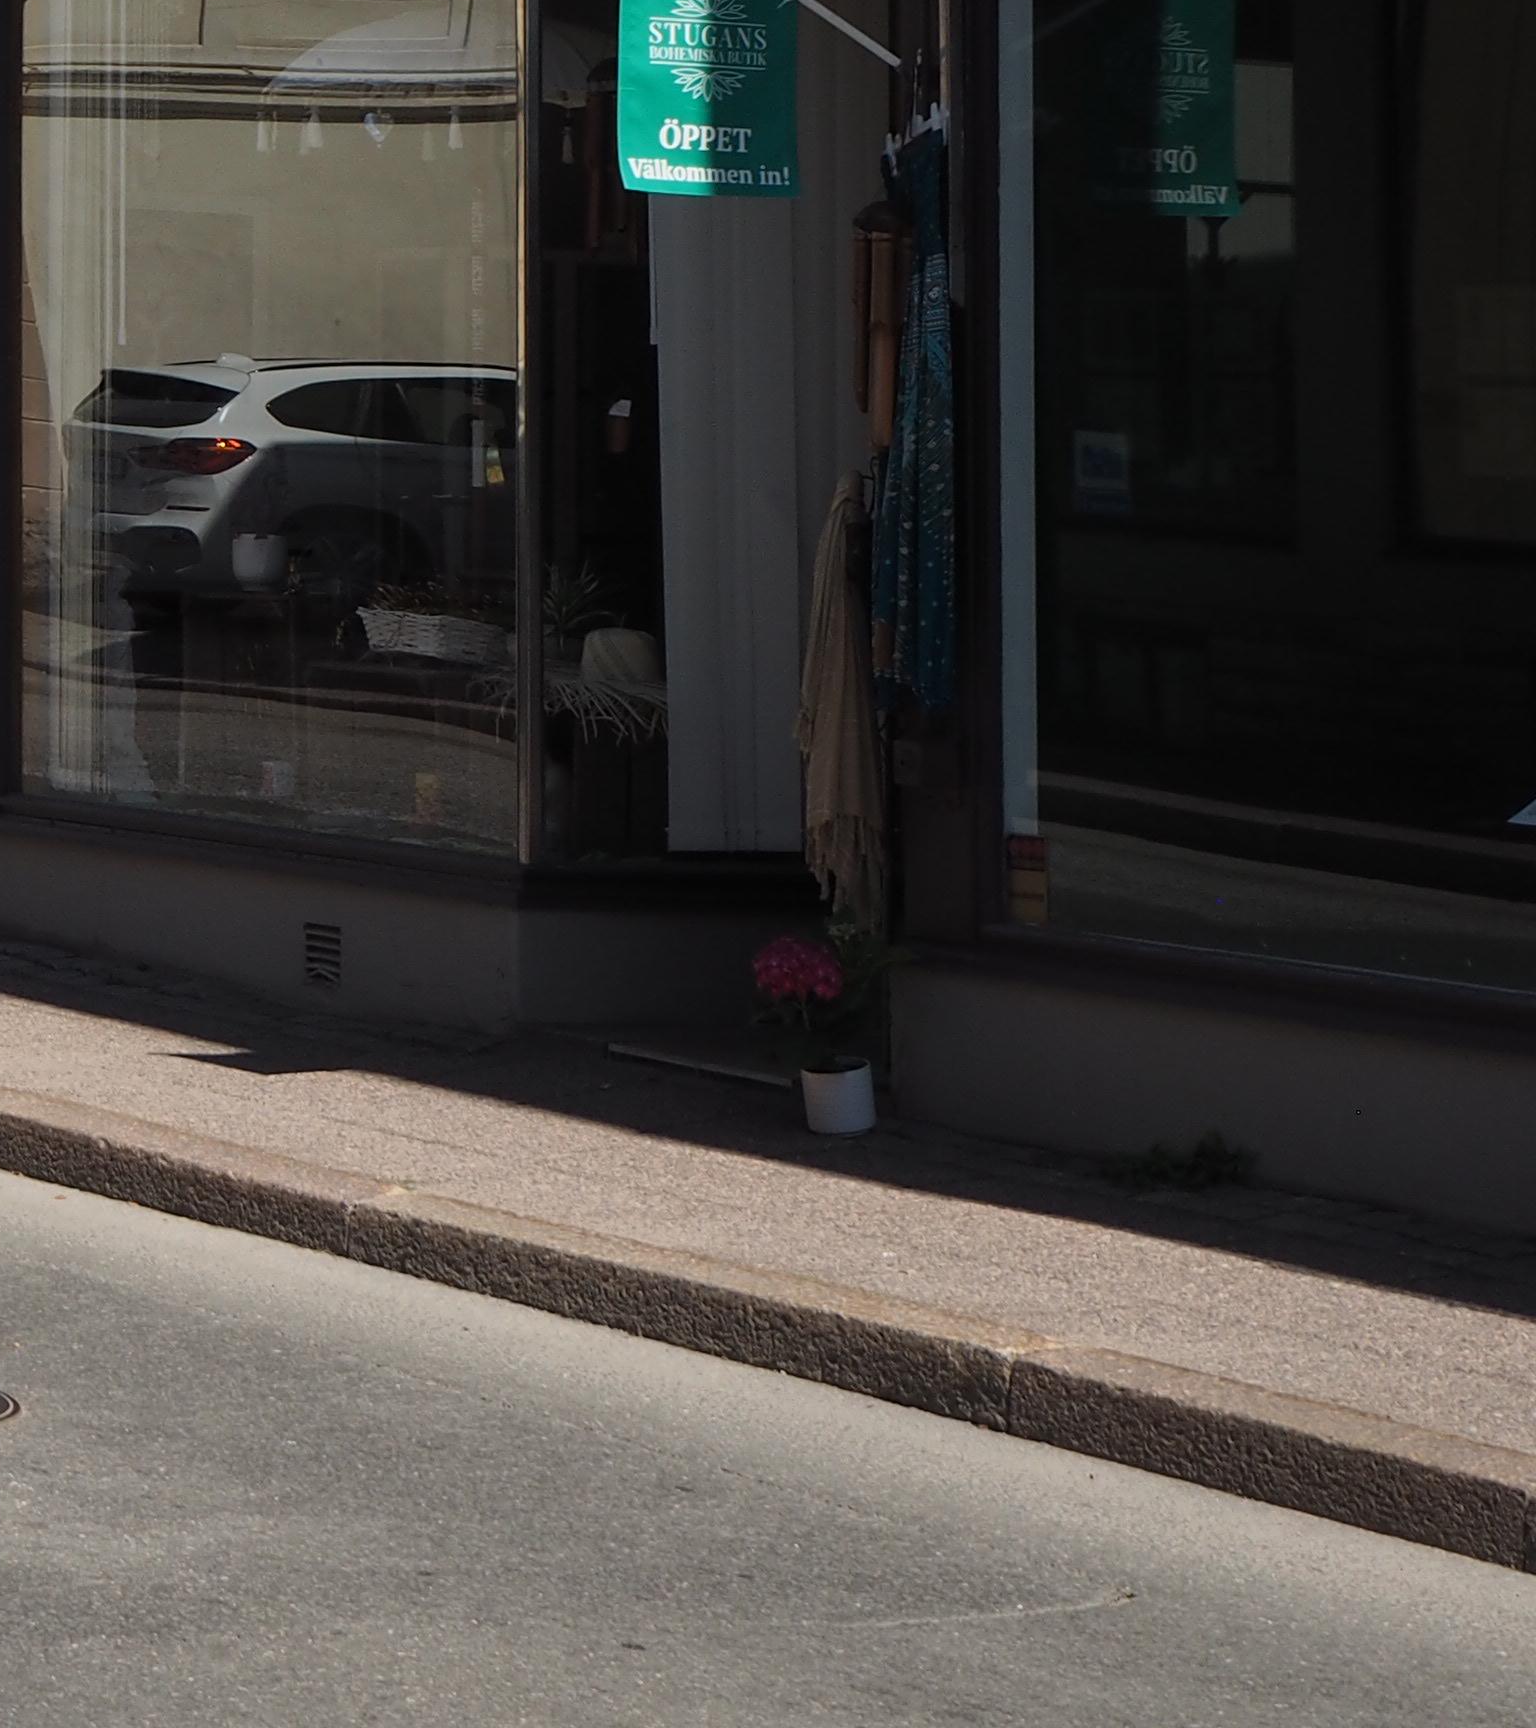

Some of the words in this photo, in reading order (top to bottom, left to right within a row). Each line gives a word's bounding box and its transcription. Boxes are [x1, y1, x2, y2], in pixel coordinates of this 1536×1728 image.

[649, 22, 767, 50] STUGANS
[649, 45, 725, 63] BOHEMISKA
[728, 51, 767, 66] BUTIK
[659, 118, 752, 153] ÖPPET
[628, 158, 754, 185] Välkommen
[760, 165, 791, 186] in!
